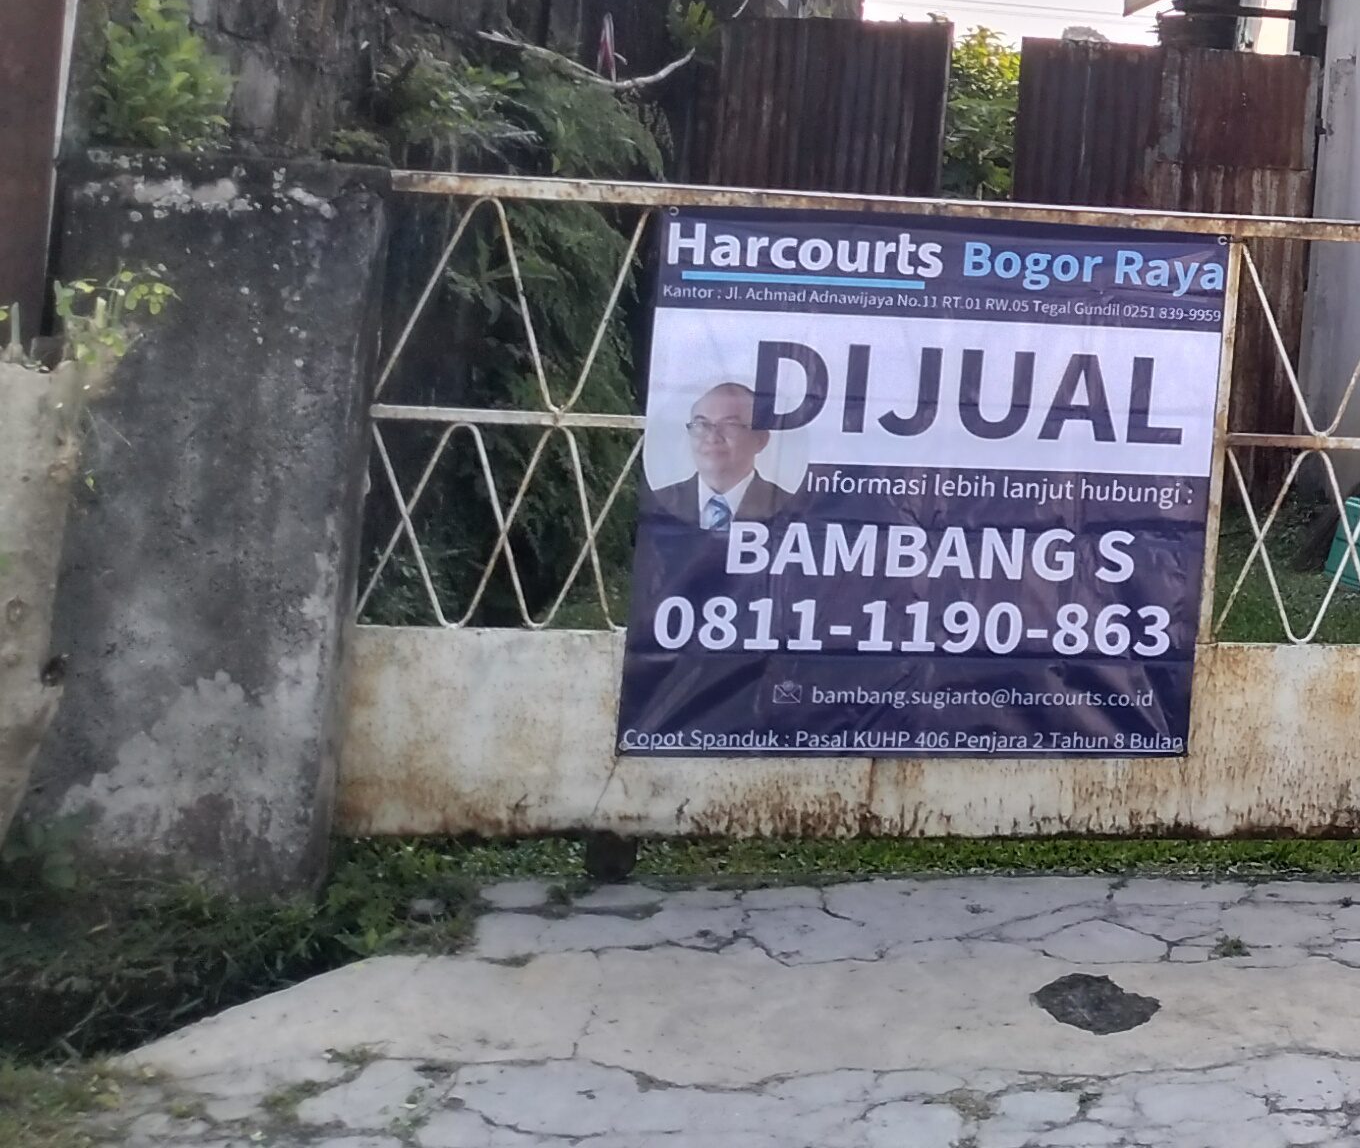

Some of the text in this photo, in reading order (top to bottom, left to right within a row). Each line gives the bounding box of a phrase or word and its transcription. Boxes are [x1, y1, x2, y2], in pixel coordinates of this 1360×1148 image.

[667, 222, 1224, 297] Harcourts Bogor Raya
[662, 283, 713, 300] Kantor
[745, 288, 807, 303] Achmad
[809, 290, 894, 309] Adnawijaya
[897, 293, 938, 308] No.11
[942, 296, 981, 311] RT.01
[985, 298, 1029, 313] RW.05
[1033, 300, 1071, 317] Tegal
[1074, 302, 1120, 317] Gundil
[1123, 305, 1156, 319] 0251
[1159, 307, 1222, 322] 839-9959
[751, 340, 1183, 445] DIJUAL
[807, 470, 927, 497] Informasi
[934, 473, 996, 498] lebih
[1003, 476, 1074, 506] lanjut
[1080, 481, 1181, 510] hubungi
[726, 521, 1136, 583] BAMBANG S
[654, 596, 1171, 657] 0811-1190-863
[812, 686, 1154, 709] bambang.sugiarto@harcourts.co.id
[623, 729, 684, 751] Copot
[690, 730, 779, 751] Spanduk
[796, 730, 847, 748] Pasal
[853, 731, 911, 748] KUHP
[915, 731, 950, 749] 406
[954, 731, 1028, 753] Penjara
[1033, 732, 1044, 749] 2
[1050, 732, 1109, 750] Tahun
[1113, 732, 1125, 750] 8
[1130, 732, 1183, 751] Bulan
